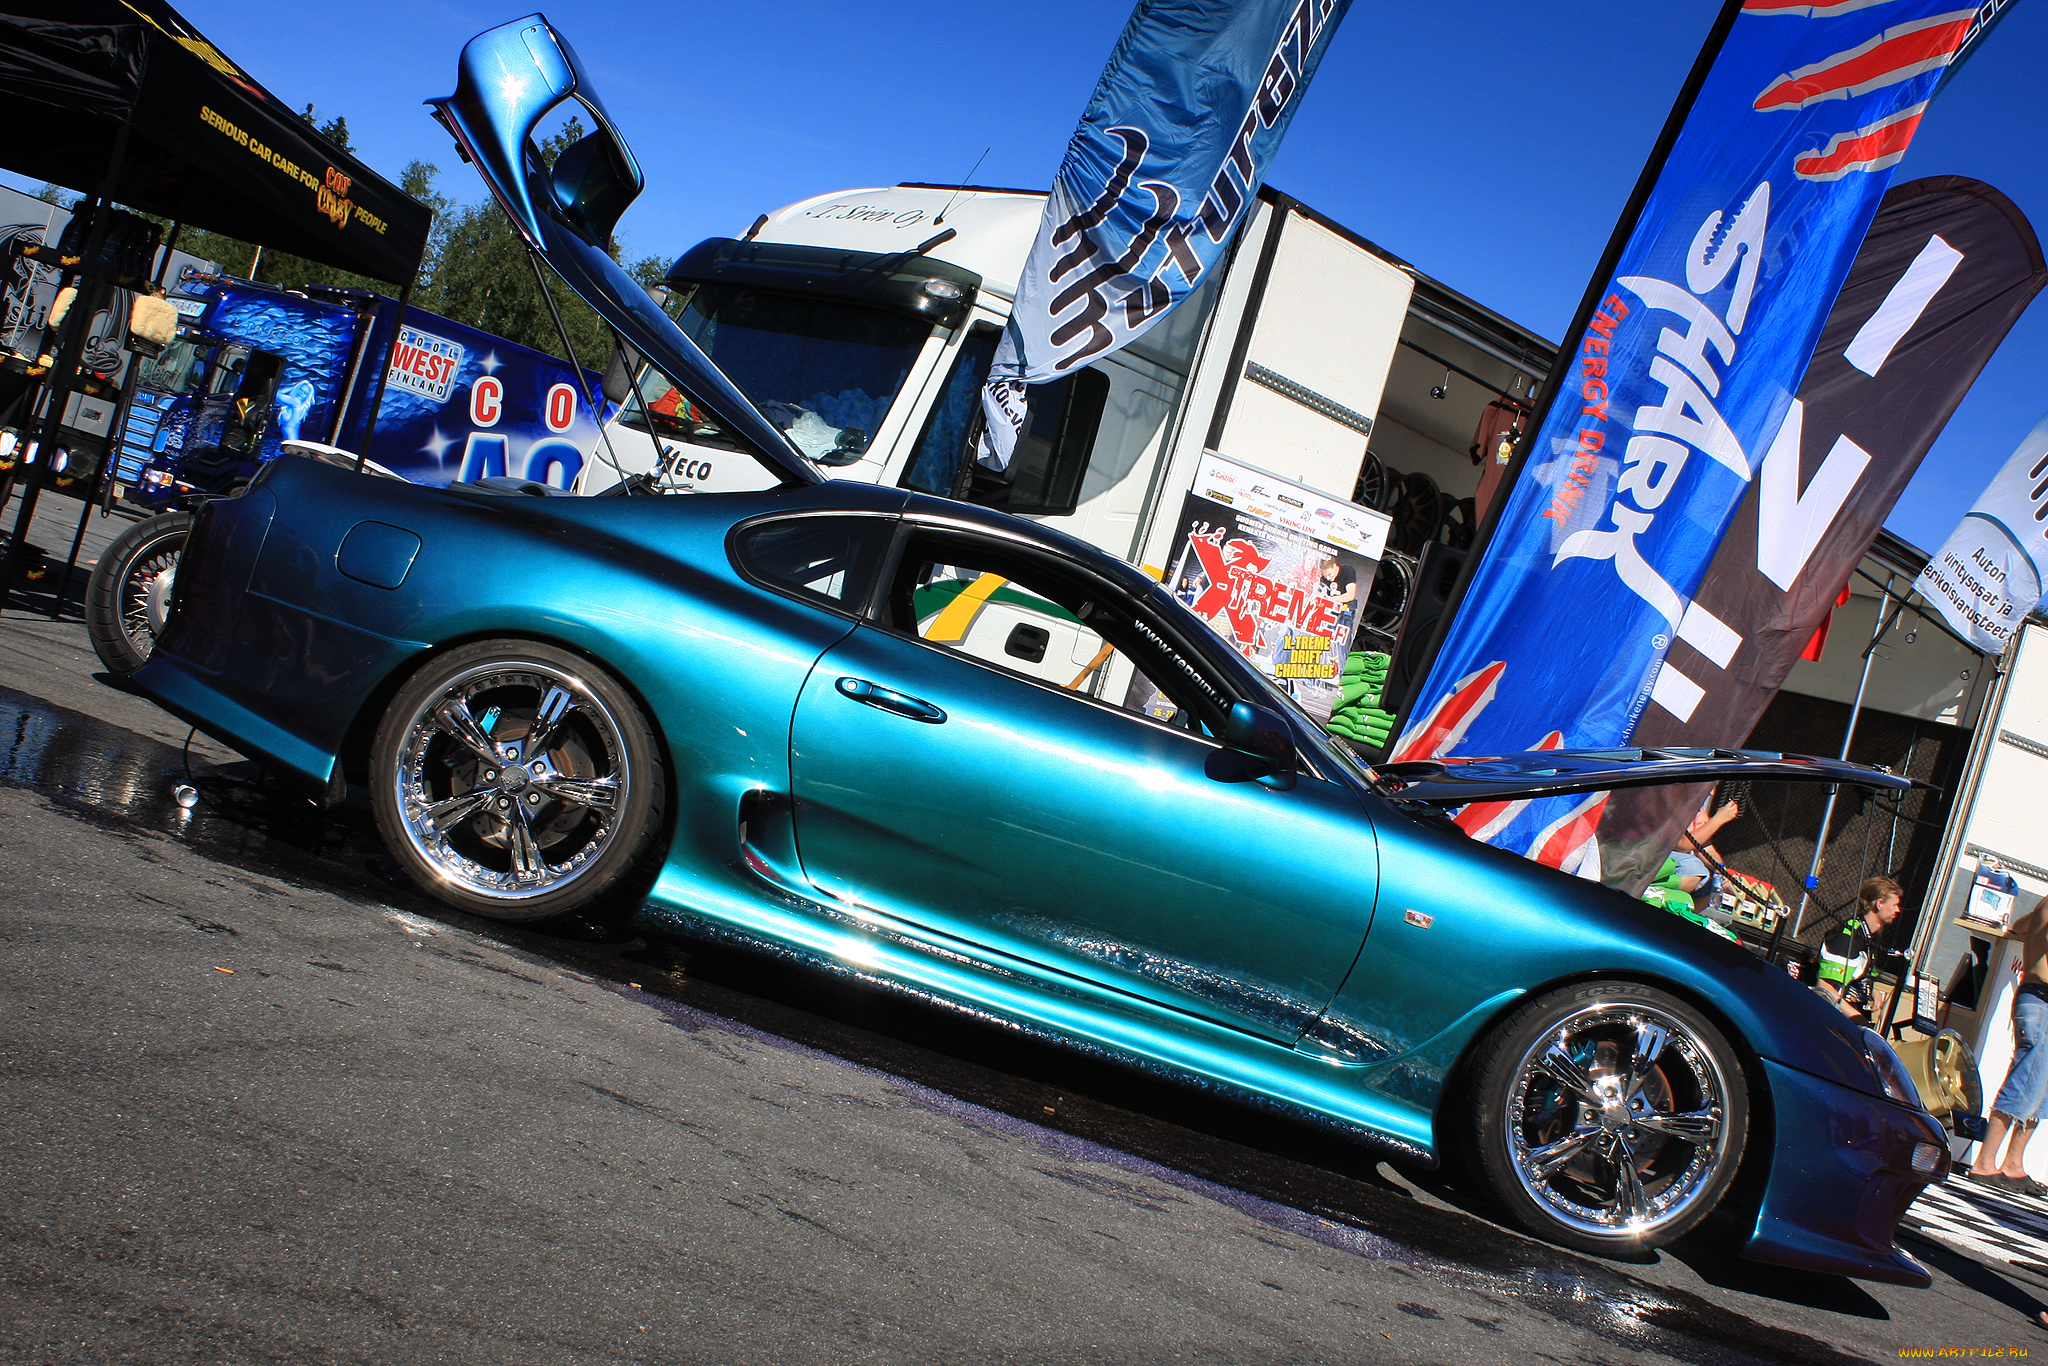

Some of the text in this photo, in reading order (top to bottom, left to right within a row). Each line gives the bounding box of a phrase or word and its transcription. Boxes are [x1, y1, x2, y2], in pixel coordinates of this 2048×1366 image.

[200, 105, 320, 192] SERIOUS CAR CARE FOR
[354, 206, 388, 235] PEOPLE
[401, 332, 453, 358] COOL
[1581, 293, 1631, 423] ENERGY
[392, 341, 456, 385] WEST
[388, 369, 444, 396] FINLAND
[1552, 181, 1771, 638] SHARK
[1541, 429, 1606, 530] DRINK
[1279, 516, 1302, 530] VIKING
[1302, 525, 1317, 536] LINE
[1971, 546, 2007, 585] Auton
[1943, 551, 2013, 617] viritysosat ja
[1923, 564, 2009, 640] erikoisvarusteet
[1283, 635, 1331, 650] X-TREME
[1290, 649, 1322, 664] DRIFT
[1275, 663, 1335, 679] CHALLENGE
[1574, 985, 1651, 1001] ECSTA
